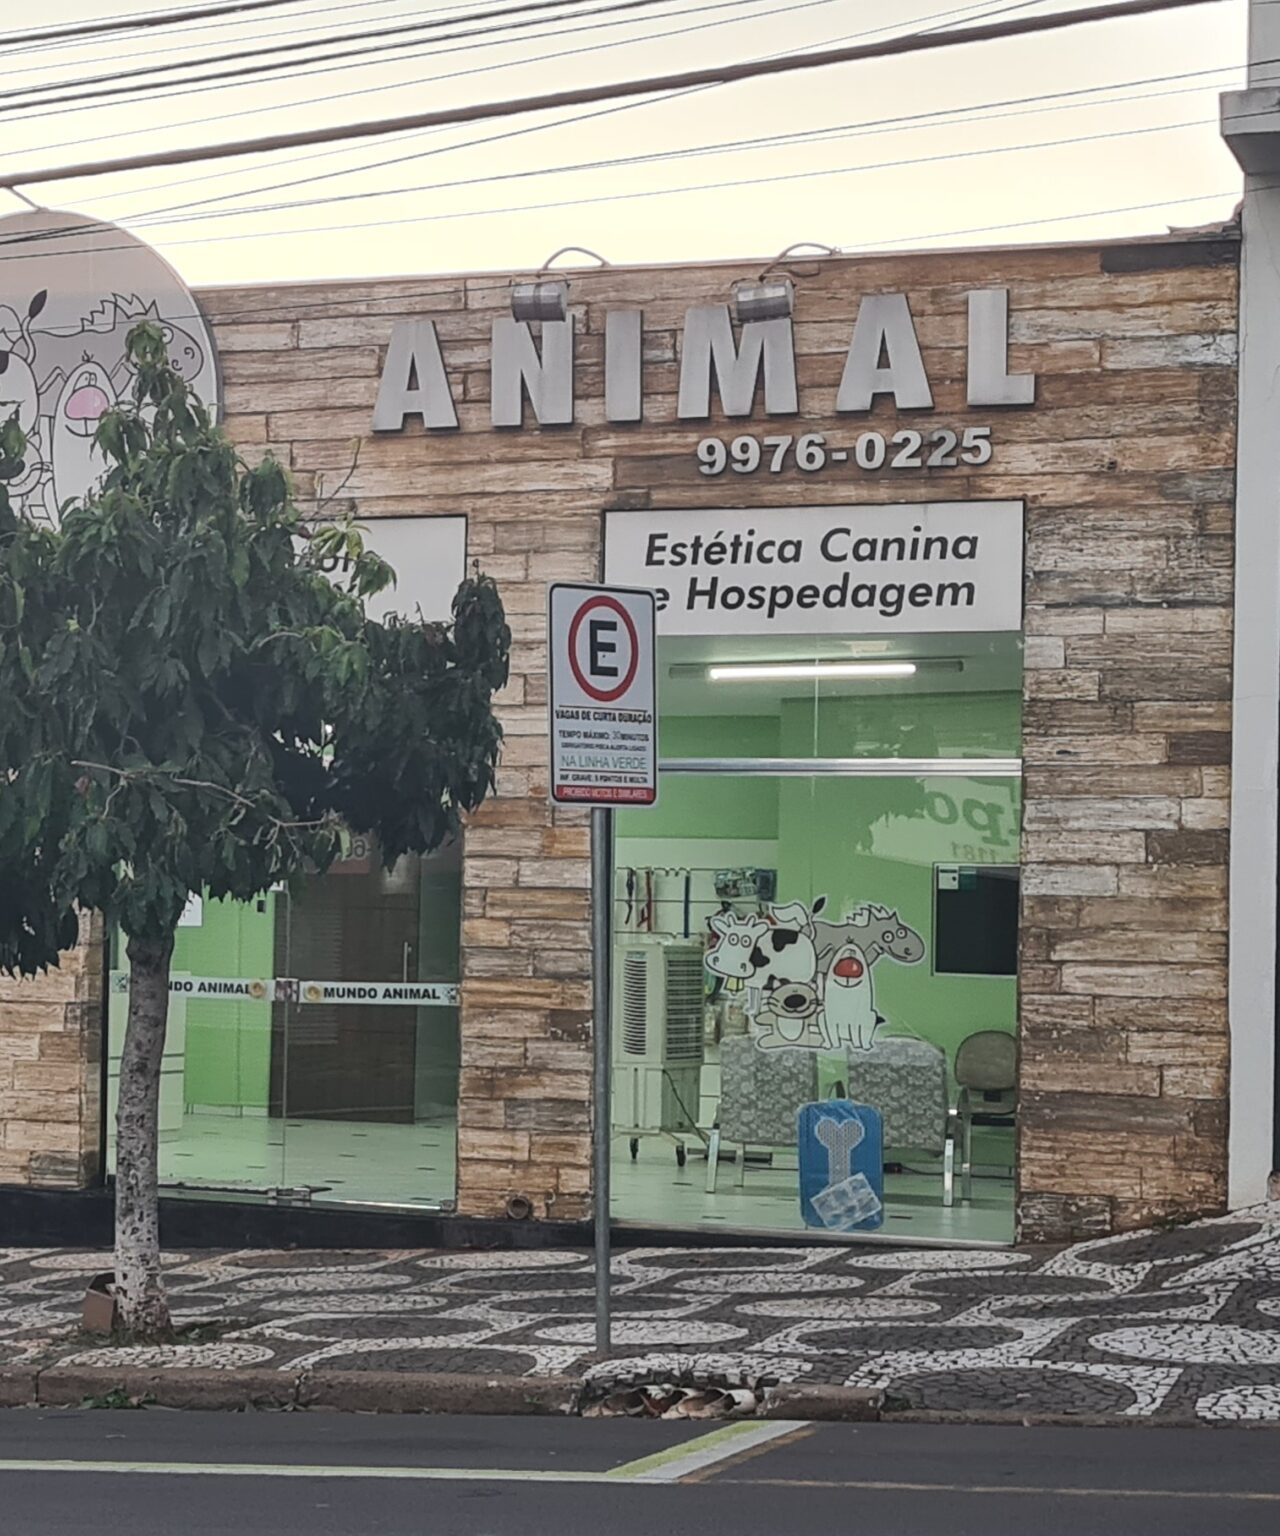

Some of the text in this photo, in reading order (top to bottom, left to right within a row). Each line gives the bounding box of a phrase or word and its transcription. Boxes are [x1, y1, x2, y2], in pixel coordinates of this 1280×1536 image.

[371, 288, 1035, 432] ANIMAL
[696, 427, 993, 477] 9976-0225
[645, 526, 979, 567] Estética Canina
[687, 574, 977, 618] Hospedagem
[590, 619, 618, 677] E
[555, 709, 580, 720] VAGAS
[581, 710, 591, 721] DE
[593, 711, 617, 722] CURTA
[561, 755, 647, 769] NA LINHA VERDE
[323, 986, 440, 1001] MUNDO ANIMAL
